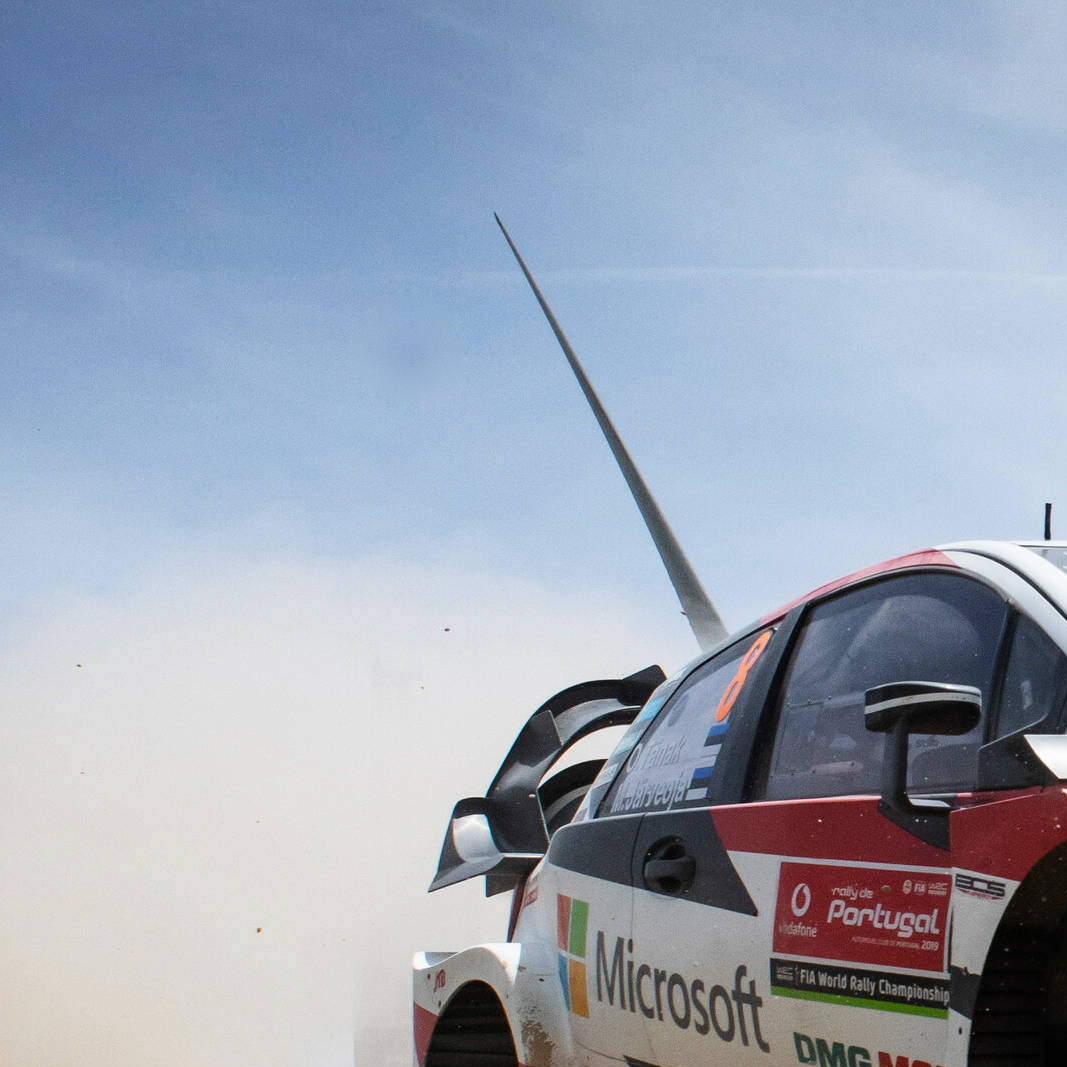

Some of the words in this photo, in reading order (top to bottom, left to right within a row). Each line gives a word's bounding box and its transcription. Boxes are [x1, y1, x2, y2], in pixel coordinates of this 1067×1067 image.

[716, 631, 771, 722] 8
[832, 886, 858, 900] rally
[859, 887, 874, 899] de
[778, 922, 818, 938] vodafone
[827, 899, 940, 938] Portugal
[921, 940, 940, 951] 2019
[596, 930, 771, 1053] Microsoft
[800, 968, 816, 984] FIA
[818, 972, 847, 990] World
[850, 975, 876, 996] Rally
[878, 979, 950, 1006] Championship
